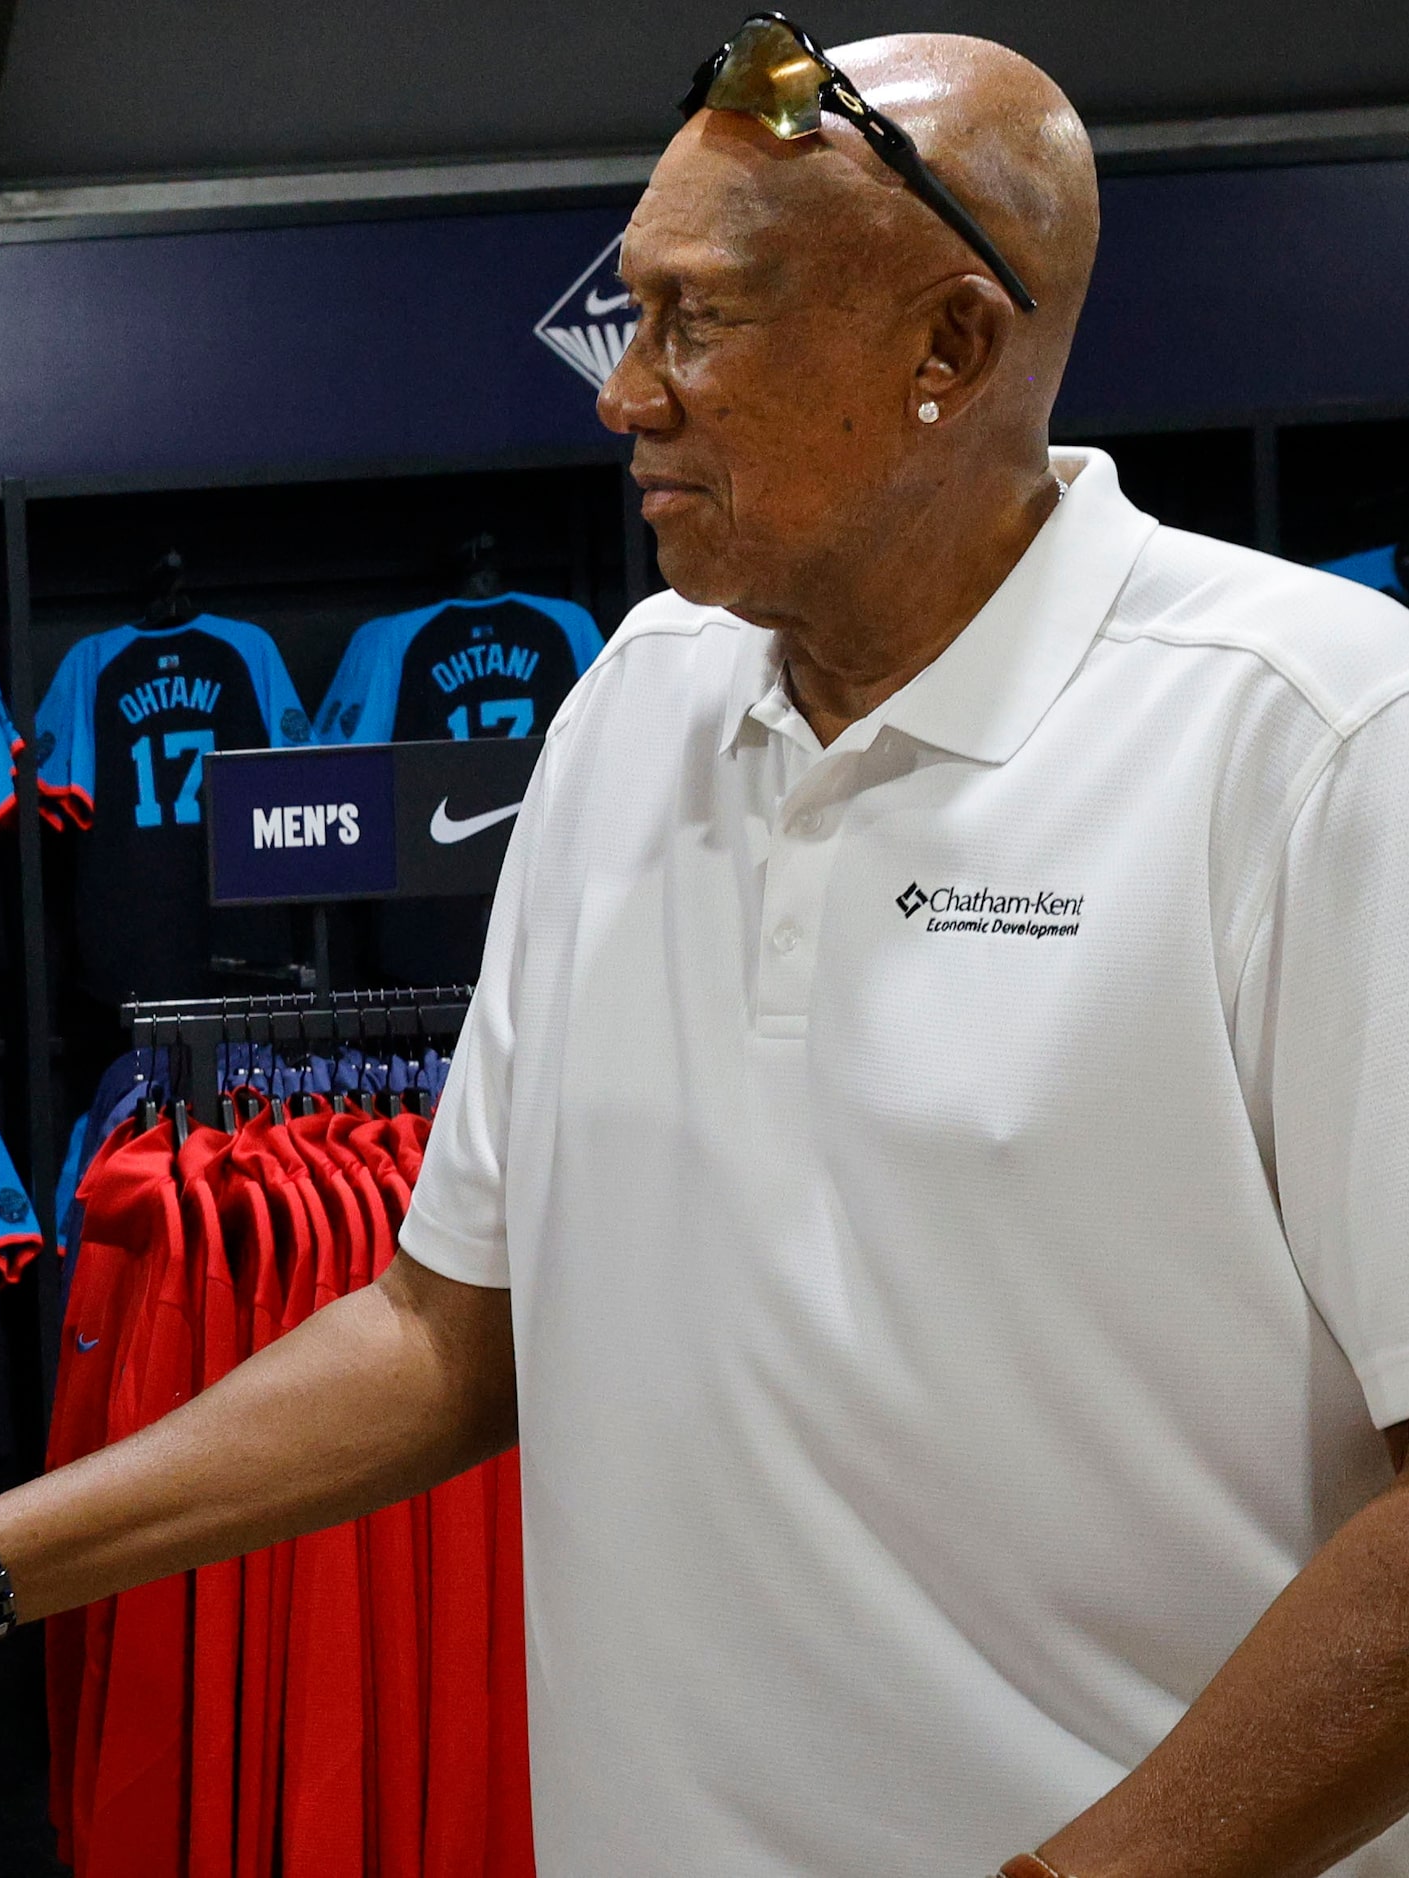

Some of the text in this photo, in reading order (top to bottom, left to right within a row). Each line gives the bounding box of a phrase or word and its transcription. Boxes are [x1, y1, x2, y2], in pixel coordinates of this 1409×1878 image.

[432, 643, 539, 693] OHTANI
[119, 676, 222, 724] OHTANI
[131, 730, 217, 828] 17
[252, 803, 361, 850] MEN'S
[930, 886, 1085, 917] Chatham-Kent
[927, 917, 1080, 940] Economic Development
